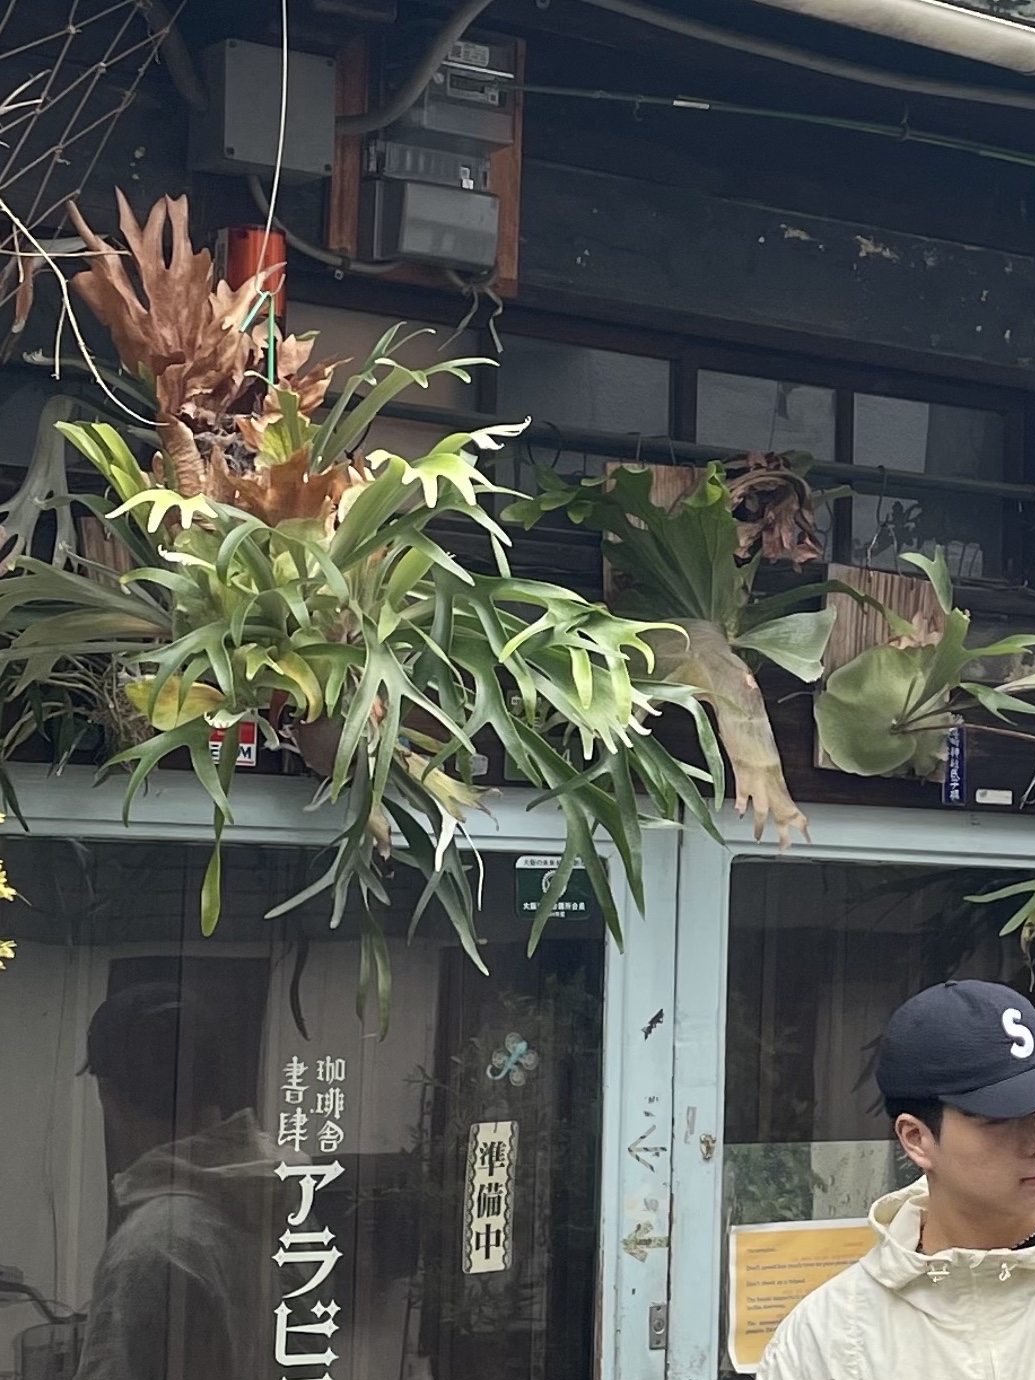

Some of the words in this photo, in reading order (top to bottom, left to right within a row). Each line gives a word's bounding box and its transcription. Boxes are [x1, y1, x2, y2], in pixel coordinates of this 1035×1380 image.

[1002, 1007, 1035, 1059] S
[277, 1055, 310, 1152] 書肆
[316, 1055, 346, 1152] 珈琲舎
[475, 1141, 507, 1260] 準備中
